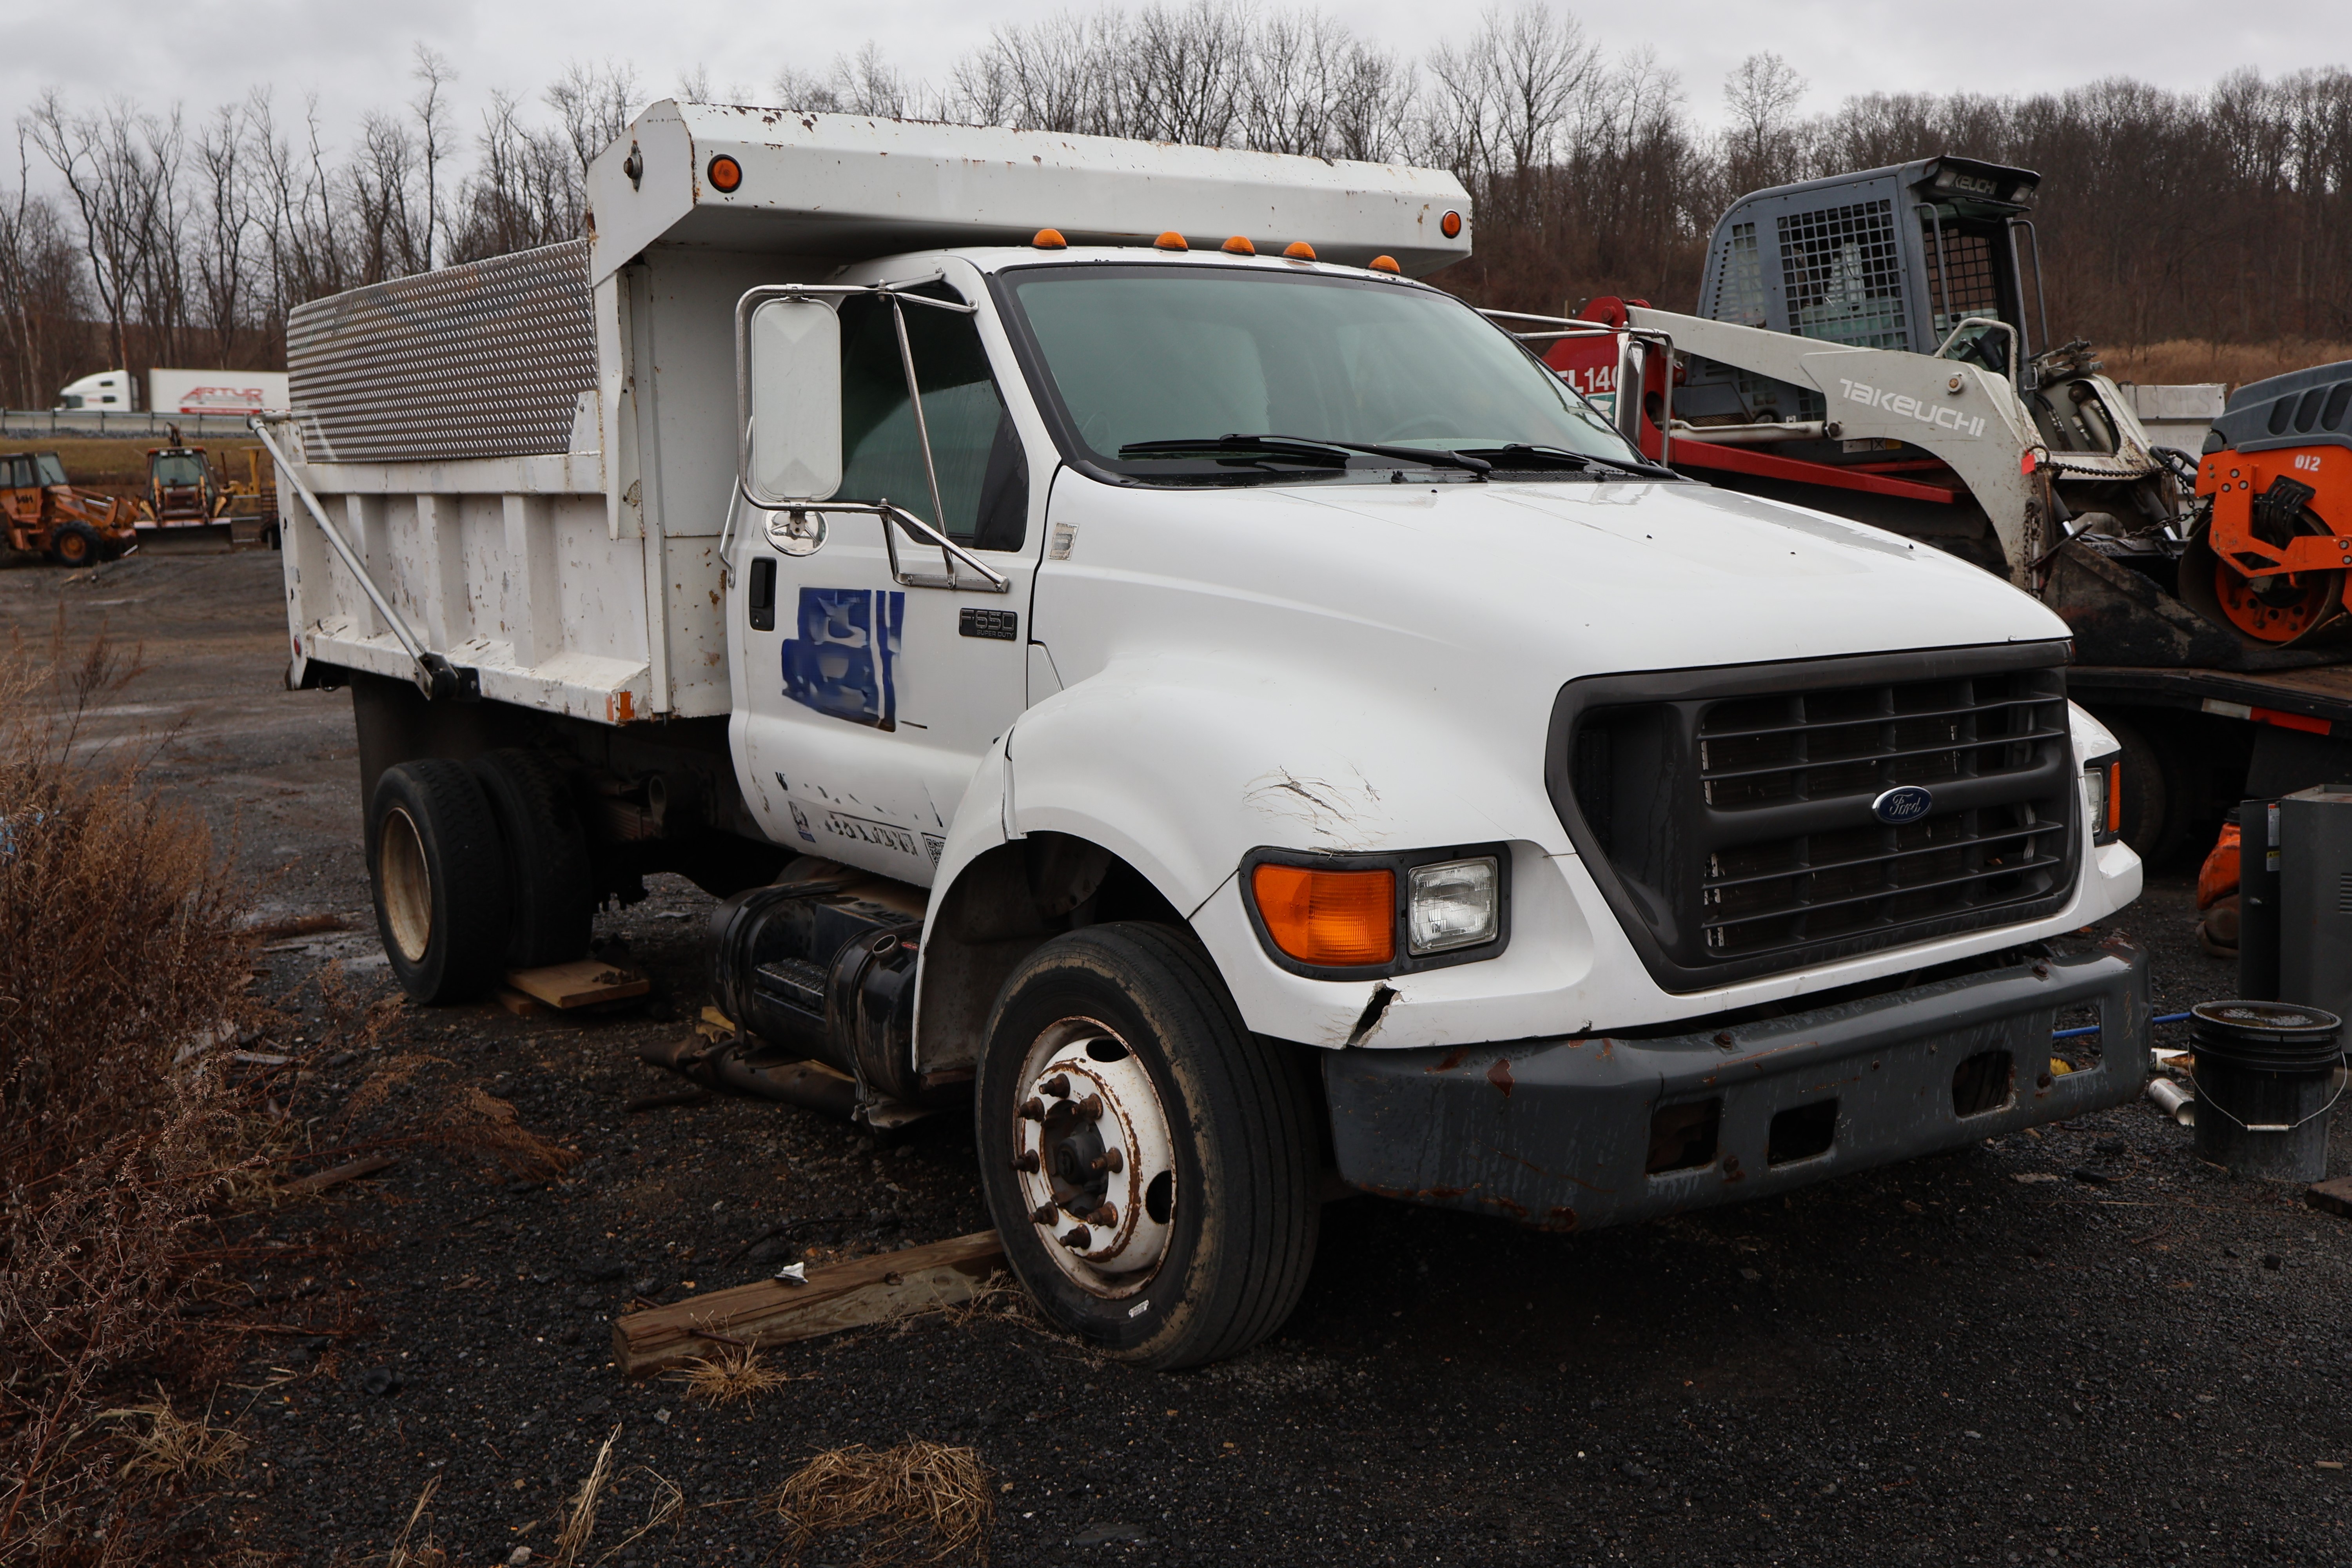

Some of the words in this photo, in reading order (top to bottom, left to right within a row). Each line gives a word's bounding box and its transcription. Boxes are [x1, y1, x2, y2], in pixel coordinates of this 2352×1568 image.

[1955, 176, 1998, 194] KEUCHI
[180, 387, 263, 403] ARTUR
[1840, 378, 1985, 437] TAKEUCHI
[2151, 432, 2203, 446] oils.com
[2294, 454, 2321, 472] 012
[1889, 793, 1921, 815] Ford
